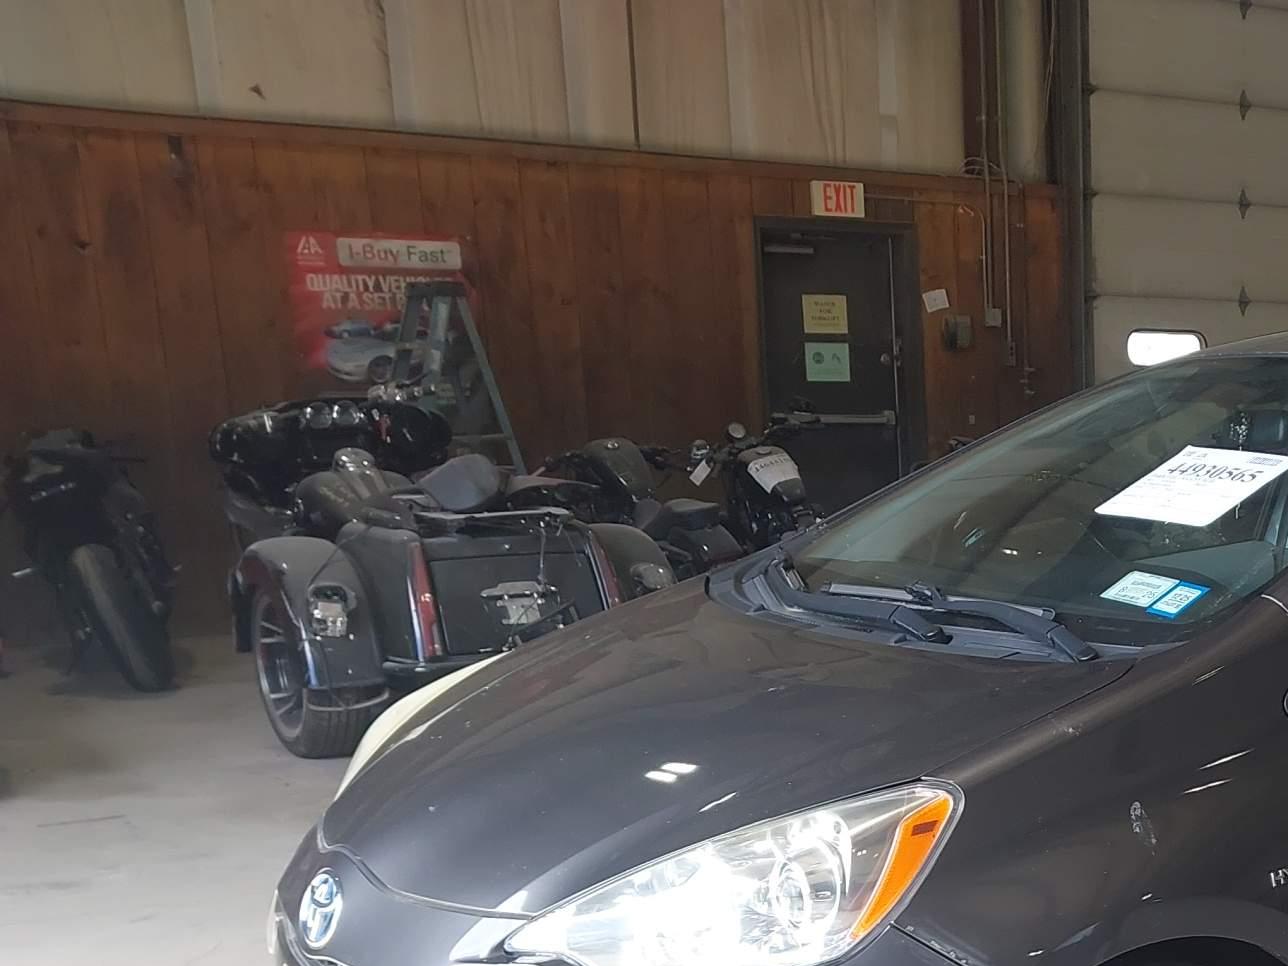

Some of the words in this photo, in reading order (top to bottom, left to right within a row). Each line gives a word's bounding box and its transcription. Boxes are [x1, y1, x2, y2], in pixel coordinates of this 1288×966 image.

[823, 183, 856, 213] EXIT
[350, 243, 399, 264] I-Buy
[406, 245, 447, 264] Fast
[306, 274, 377, 292] QUALITY
[322, 293, 347, 310] AT
[346, 293, 360, 310] A
[361, 294, 395, 312] SET
[1168, 462, 1264, 483] 44930565
